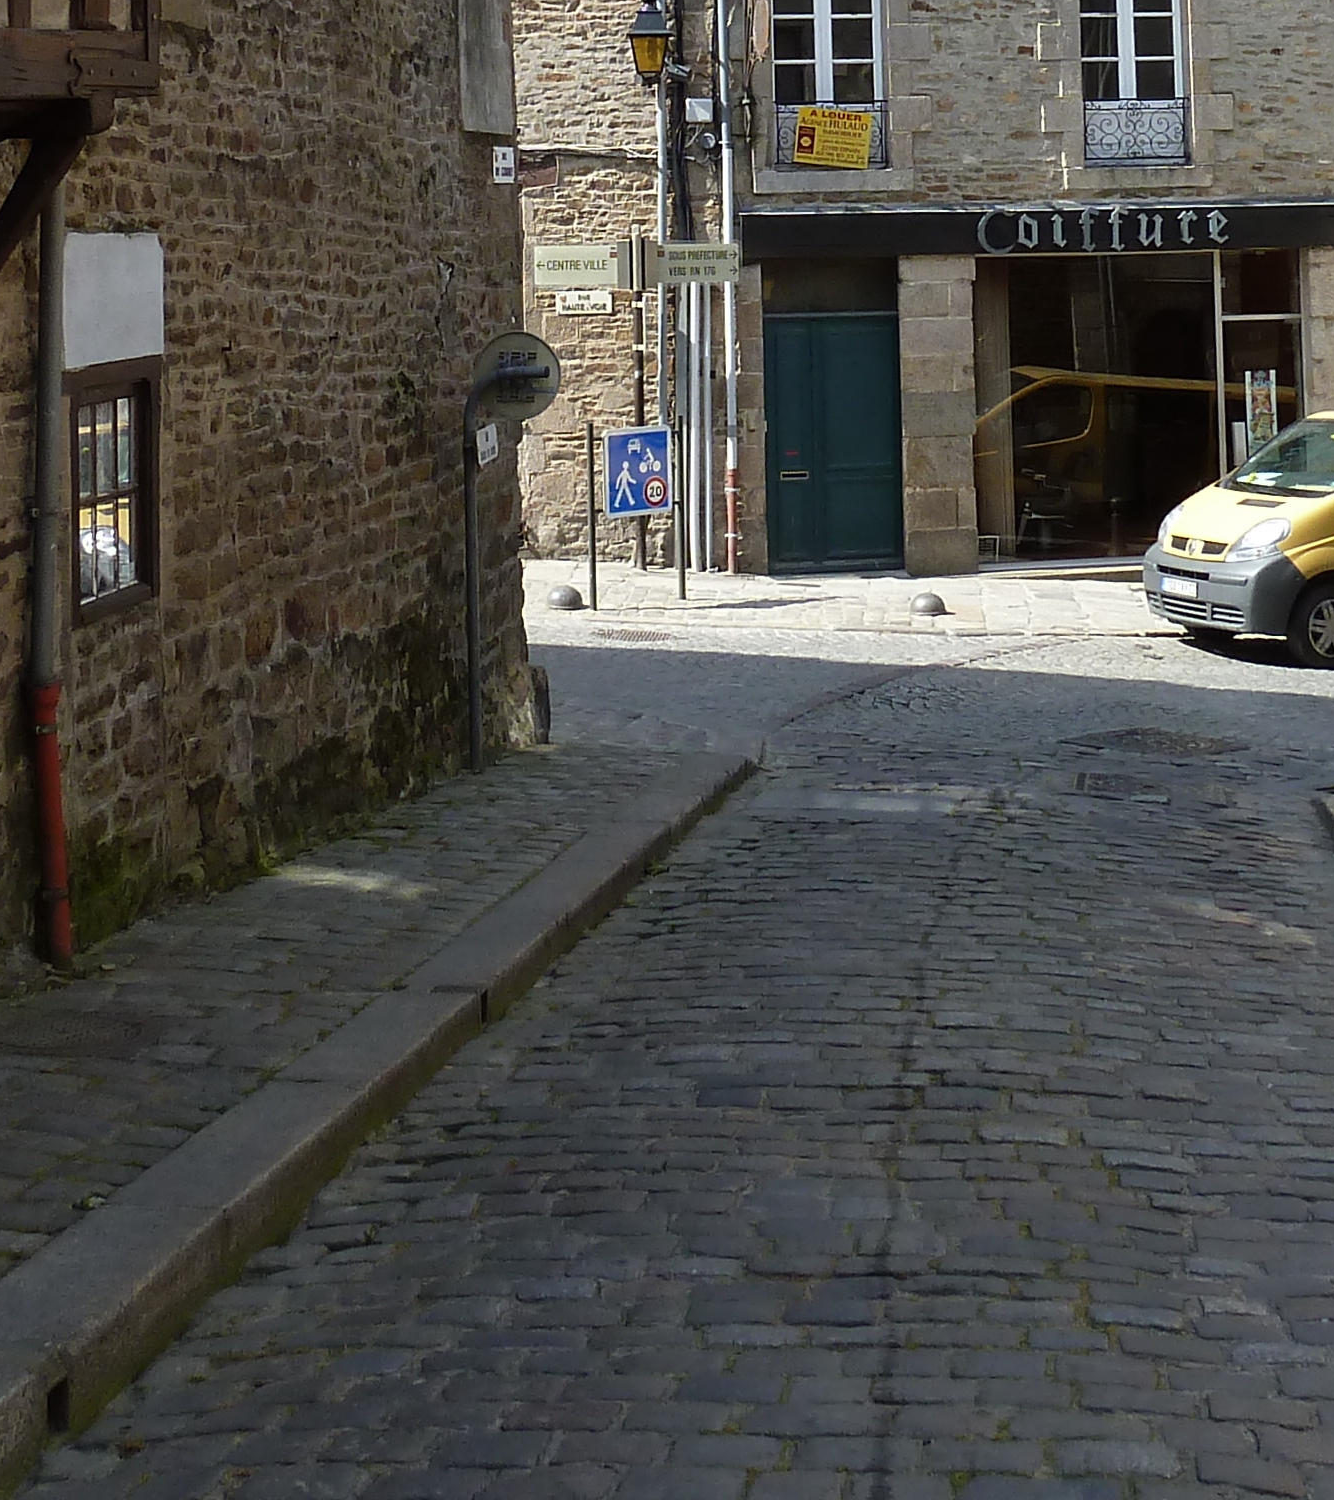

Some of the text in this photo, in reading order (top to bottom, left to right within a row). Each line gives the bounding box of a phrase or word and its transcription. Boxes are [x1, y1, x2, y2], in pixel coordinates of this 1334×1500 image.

[810, 109, 862, 121] A LOUER
[977, 205, 1229, 254] Coiffure
[547, 259, 608, 271] CENTRE VILLE
[668, 266, 686, 276] VERS
[704, 266, 716, 276] 176
[649, 485, 662, 498] 20
